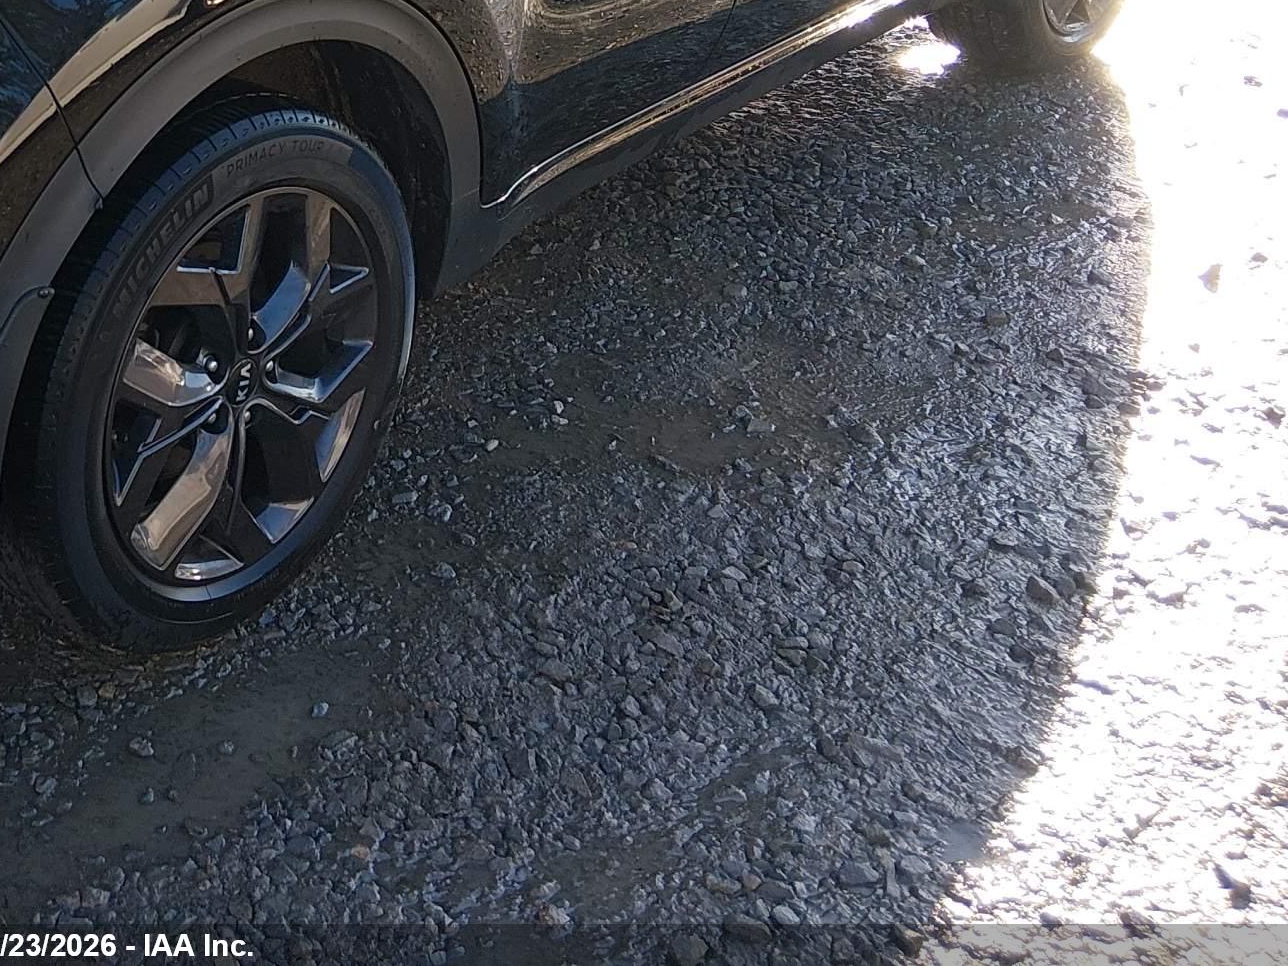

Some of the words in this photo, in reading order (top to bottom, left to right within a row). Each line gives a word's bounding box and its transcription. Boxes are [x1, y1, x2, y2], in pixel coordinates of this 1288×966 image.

[226, 141, 287, 178] PRIMACY
[113, 183, 209, 317] MICHELIN
[236, 363, 252, 402] KIA
